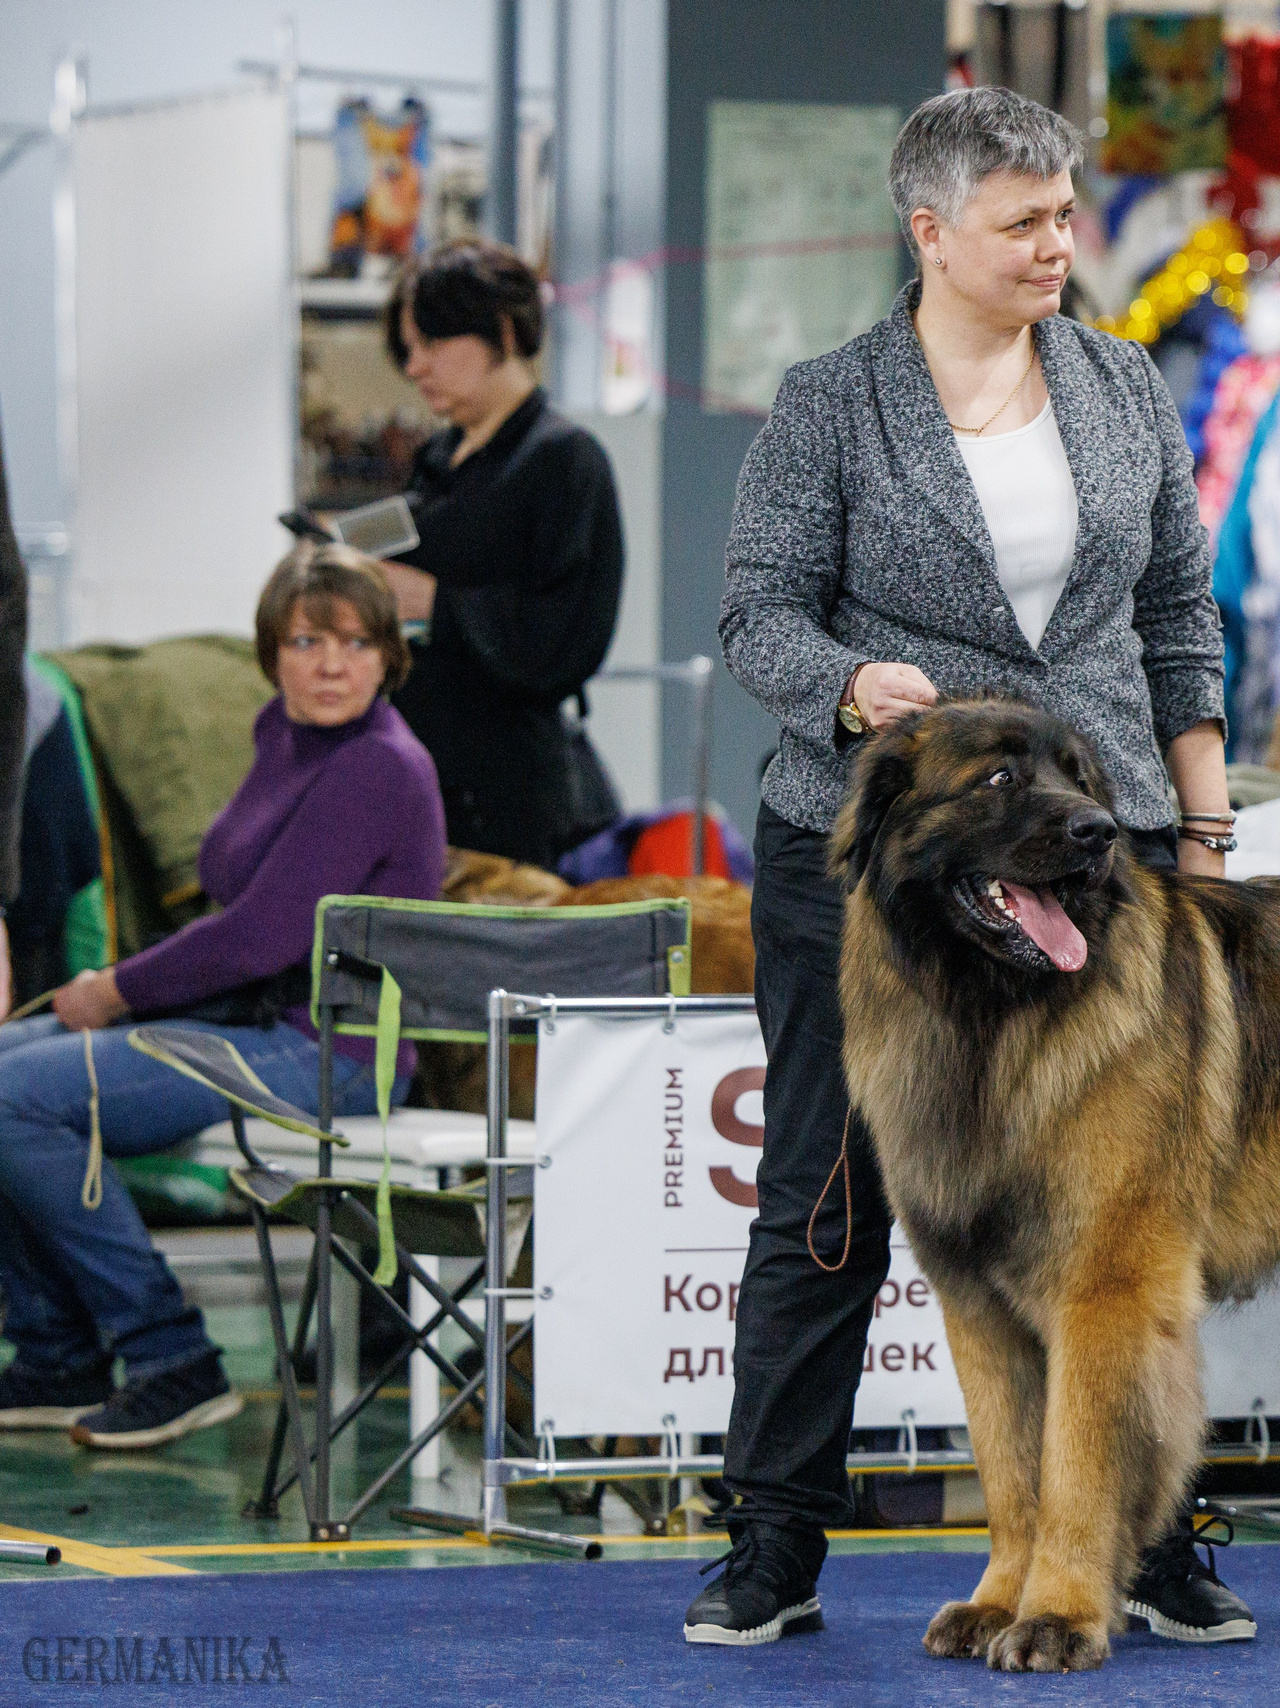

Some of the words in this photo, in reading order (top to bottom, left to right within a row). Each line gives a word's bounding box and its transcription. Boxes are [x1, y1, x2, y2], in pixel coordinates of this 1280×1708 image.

[664, 1067, 684, 1208] PREMIUM
[874, 1279, 930, 1319] ре
[663, 1346, 735, 1383] дл
